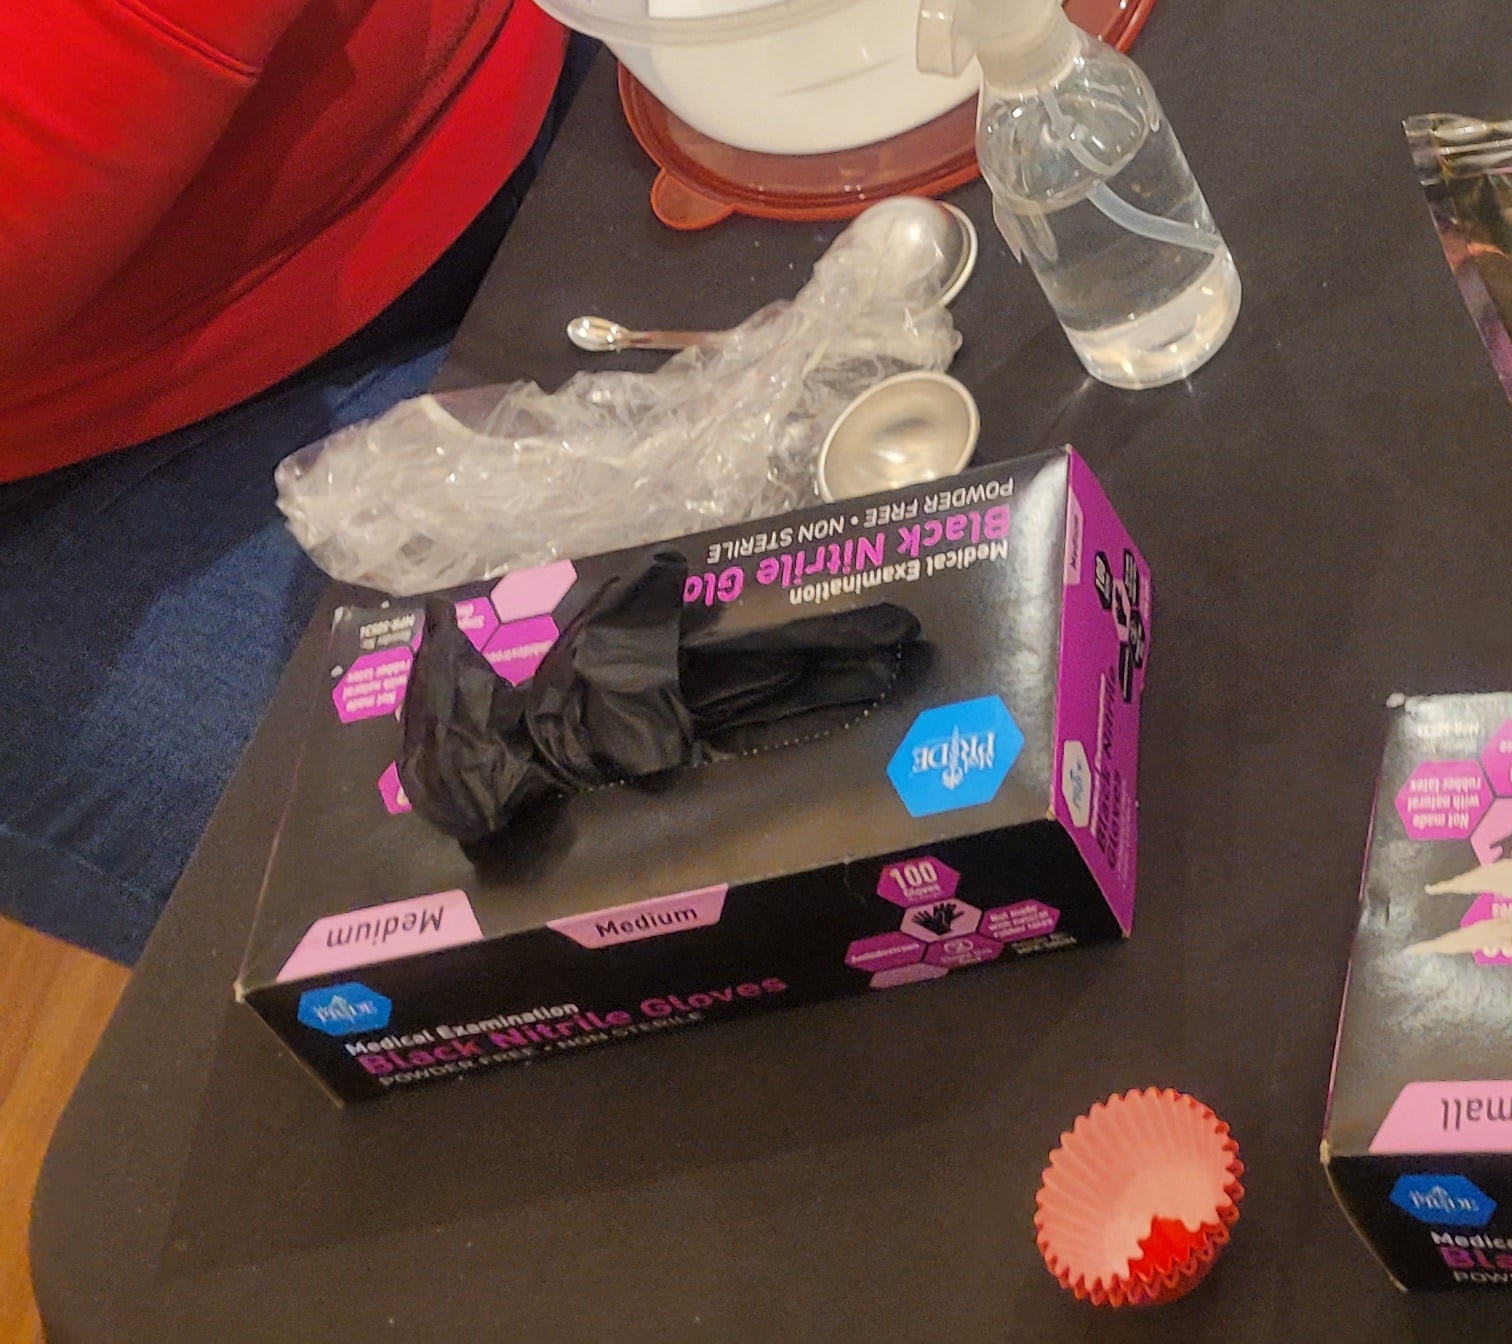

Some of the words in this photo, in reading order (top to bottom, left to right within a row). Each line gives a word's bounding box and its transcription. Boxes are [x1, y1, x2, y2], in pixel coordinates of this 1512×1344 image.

[924, 477, 1015, 506] POWDER
[798, 514, 845, 544] NON
[863, 500, 919, 529] FREE
[898, 503, 1012, 558] Black
[706, 526, 793, 564] STERILE
[755, 532, 887, 589] Nitrile
[926, 539, 1009, 577] Medical
[682, 564, 746, 607] Glo
[789, 558, 921, 606] Examination
[911, 729, 995, 783] PRIDE
[1407, 795, 1451, 812] natural
[1452, 793, 1481, 809] with
[1412, 813, 1449, 830] made
[1449, 813, 1469, 829] Not
[889, 861, 939, 890] 100
[326, 904, 445, 950] Medium
[593, 904, 700, 940] Medium
[344, 1028, 436, 1057] Medical
[435, 1002, 580, 1040] Examination
[356, 1039, 482, 1076] Black
[486, 1010, 632, 1050] Nitrile
[639, 977, 788, 1018] Gloves
